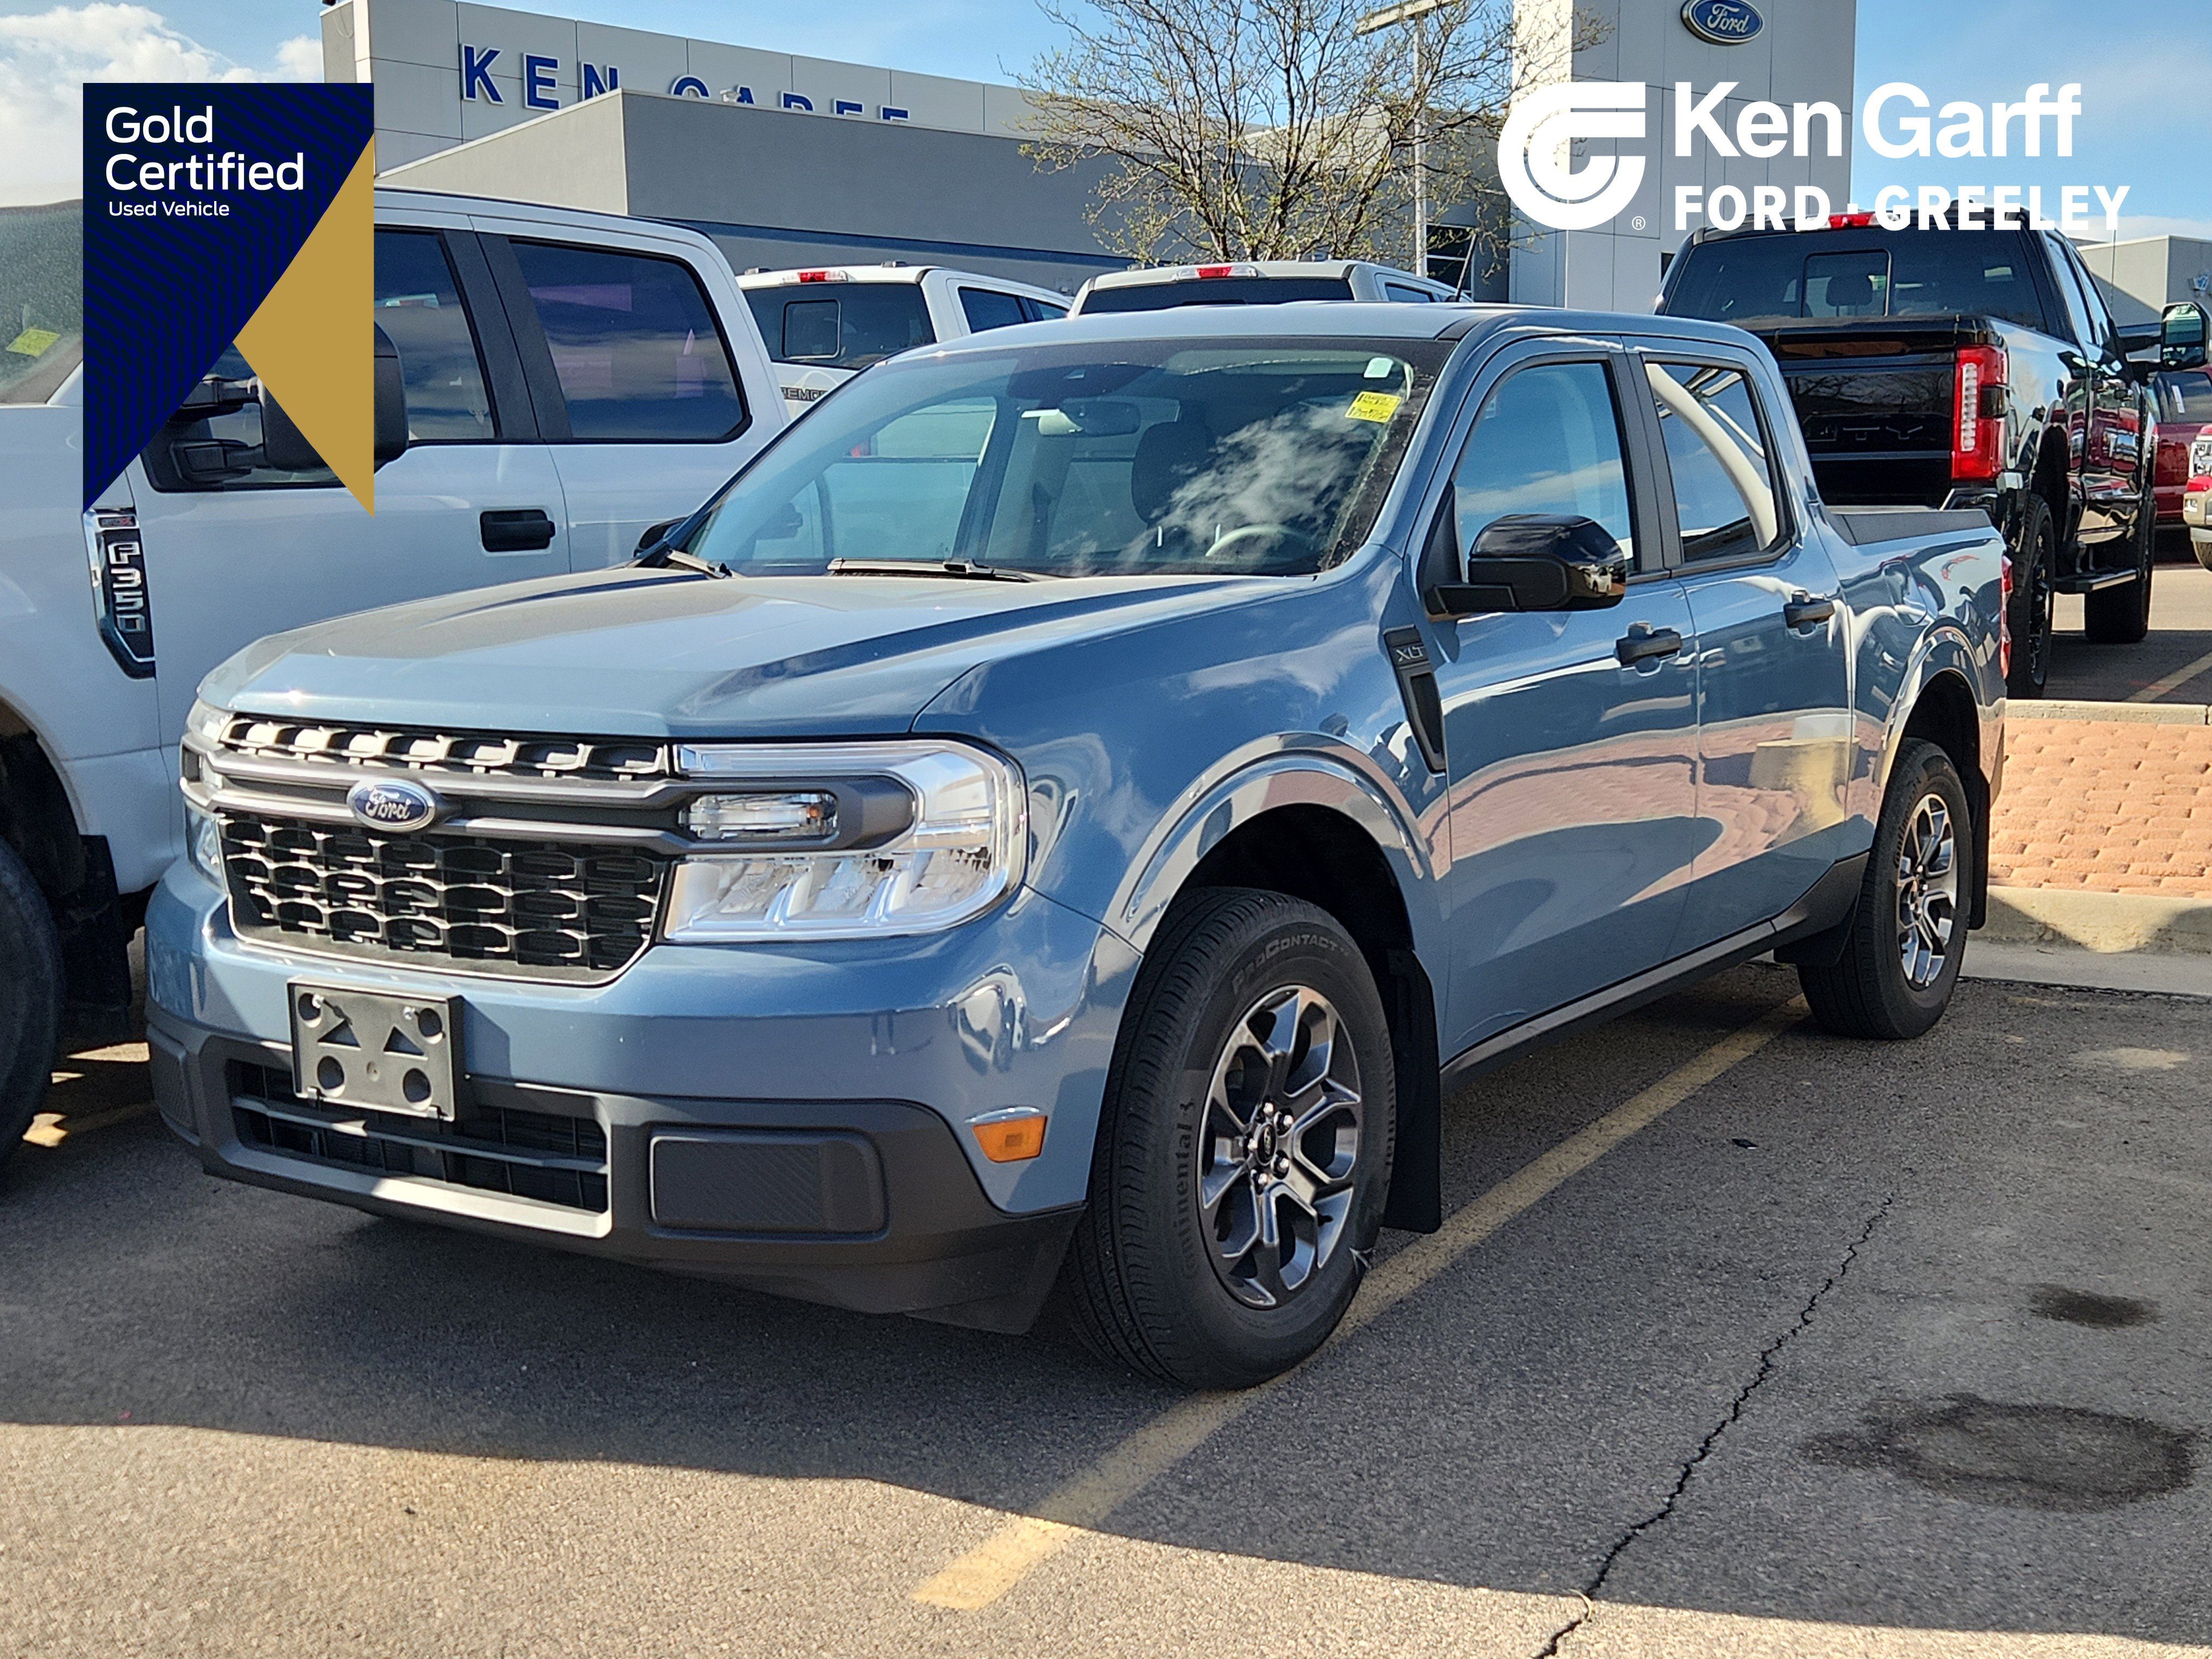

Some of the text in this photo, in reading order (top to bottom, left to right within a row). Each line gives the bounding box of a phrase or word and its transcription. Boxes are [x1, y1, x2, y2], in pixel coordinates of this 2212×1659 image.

[1707, 3, 1750, 33] Ford
[1395, 646, 1425, 662] XLT
[365, 788, 412, 819] Ford
